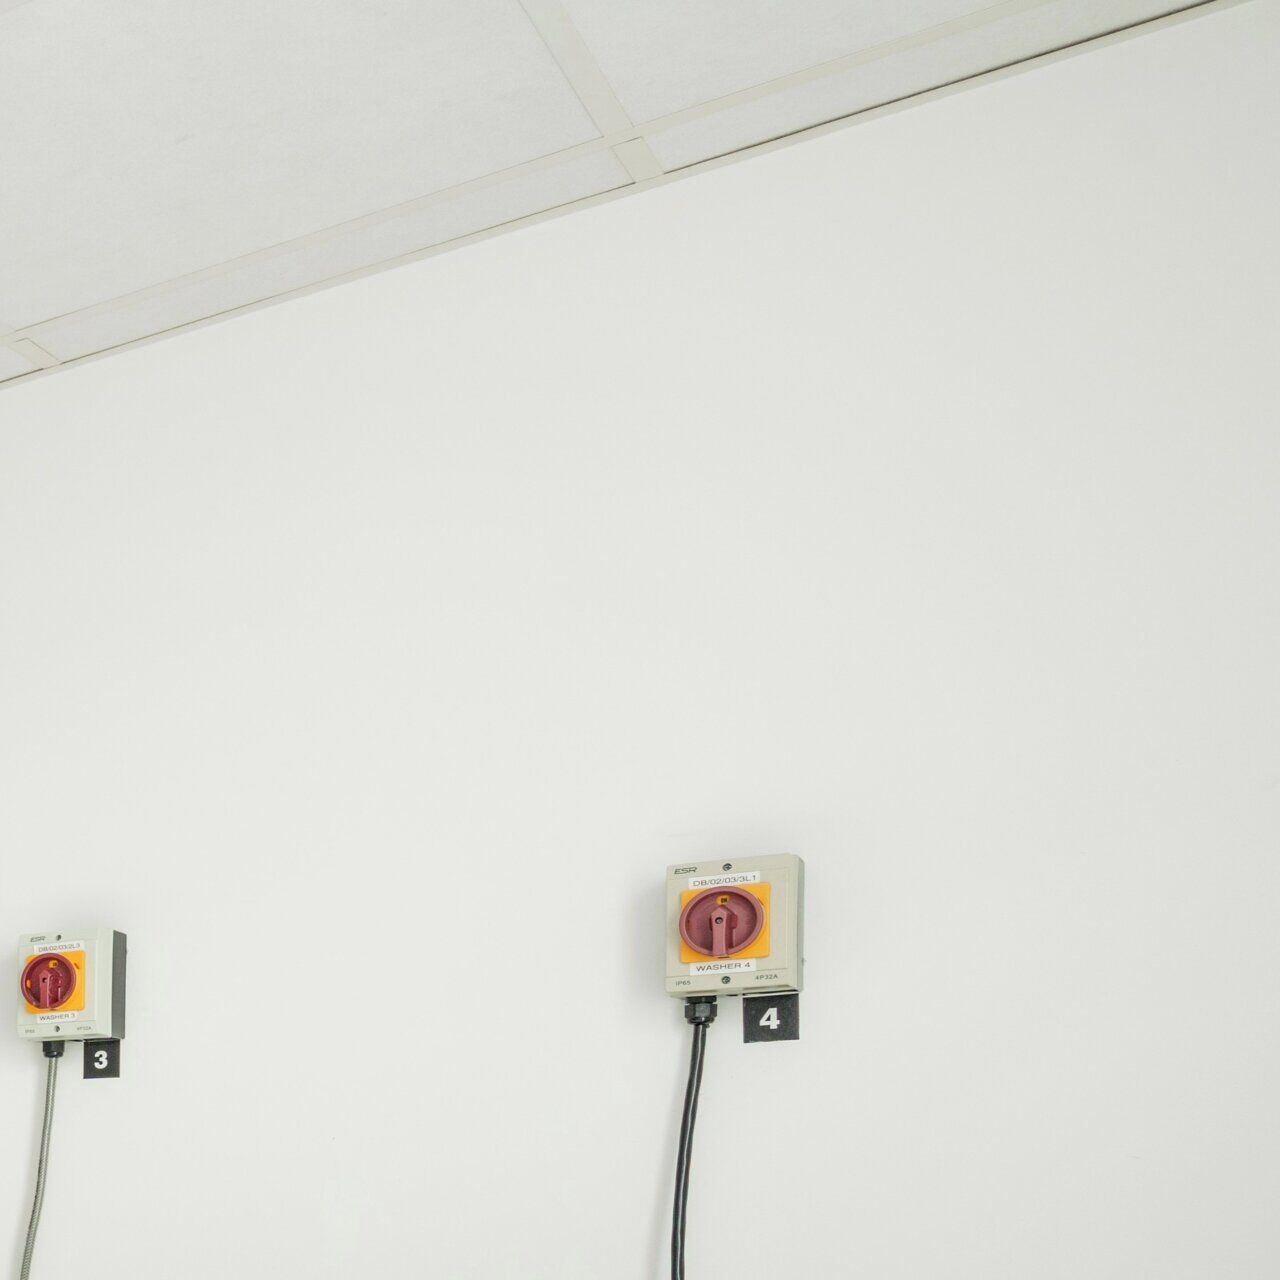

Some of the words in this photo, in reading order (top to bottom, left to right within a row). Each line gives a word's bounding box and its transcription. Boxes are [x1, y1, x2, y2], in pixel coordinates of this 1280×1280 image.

[674, 866, 698, 874] ESR
[696, 962, 740, 972] WASHER
[759, 1008, 780, 1030] 4
[94, 1050, 108, 1069] 3
